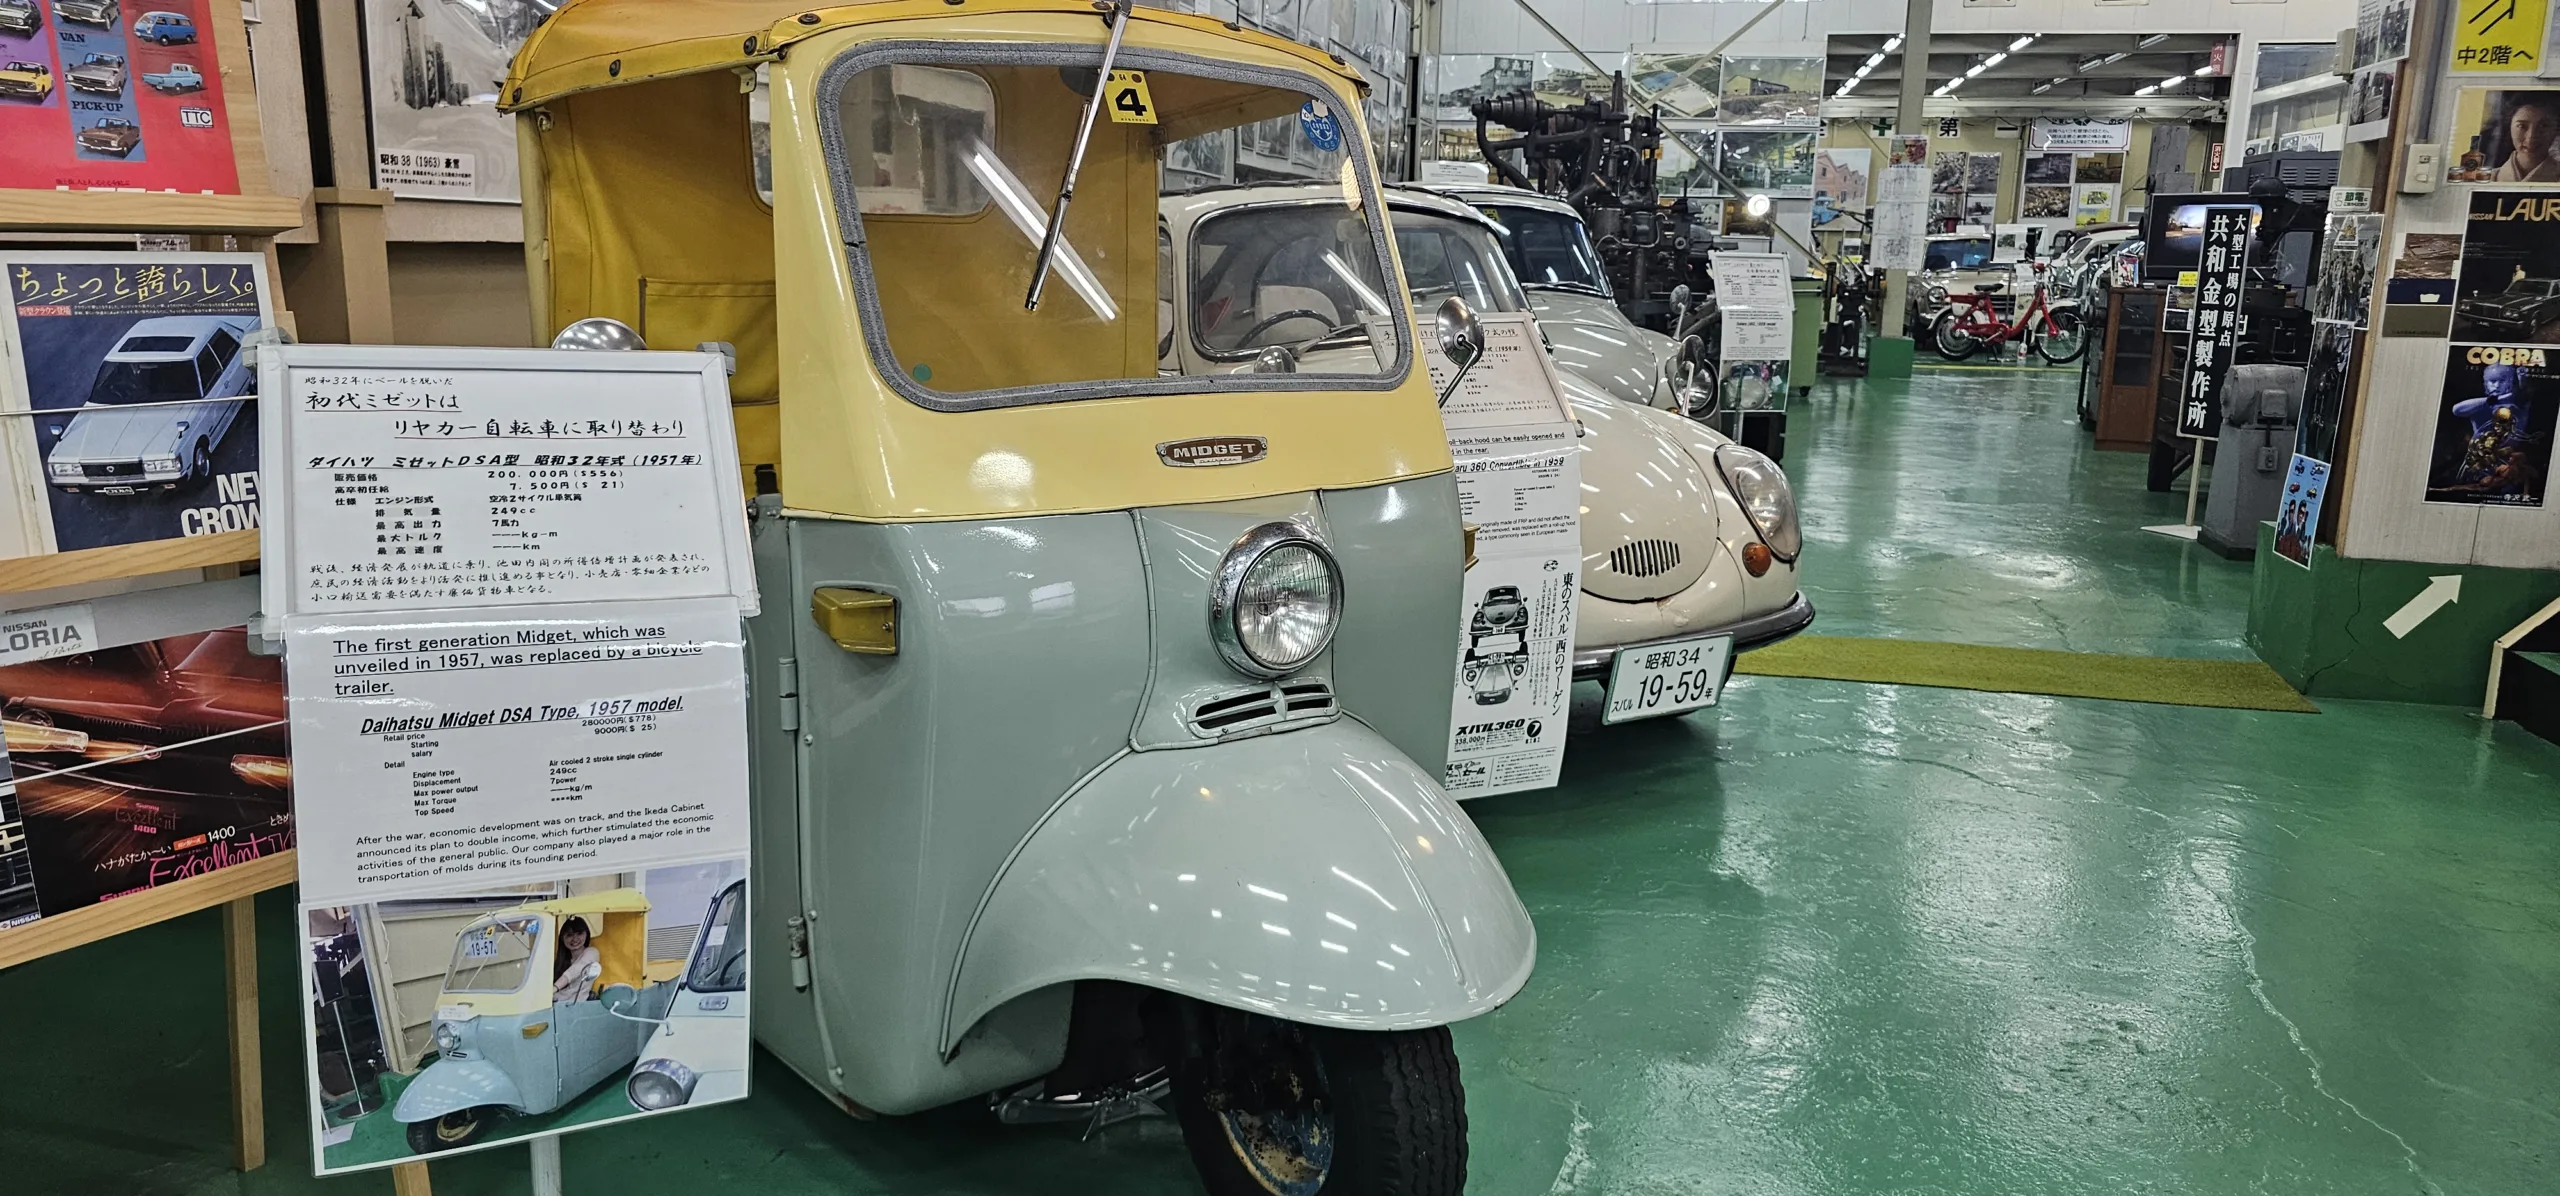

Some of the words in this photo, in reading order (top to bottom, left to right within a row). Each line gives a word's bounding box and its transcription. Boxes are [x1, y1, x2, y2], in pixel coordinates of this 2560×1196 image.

[59, 32, 85, 42] VAN
[2457, 45, 2534, 65] 中2階へ
[72, 101, 124, 112] PICK-UP
[1115, 88, 1147, 116] 4
[183, 110, 211, 124] TTC
[380, 153, 399, 166] 昭和
[401, 155, 411, 167] 38
[415, 155, 441, 168] (1963)
[16, 266, 253, 300] ちょっと誇らしく。
[2219, 214, 2246, 347] 大型工場の原点
[2186, 215, 2230, 429] 共和金型製作所
[2466, 347, 2546, 367] COBRA
[304, 376, 453, 386] 昭和32年にベールを脱いだ
[305, 391, 459, 410] 初代ミゼットは
[395, 419, 684, 438] リヤカー自転車に取り替わり
[1513, 434, 1530, 442] easily
[1531, 432, 1553, 440] opened
[1173, 443, 1256, 458] MIDGET
[1470, 462, 1486, 472] 360
[1544, 456, 1565, 467] 1959
[335, 473, 378, 482] 販売価格
[335, 486, 389, 494] 高卒初任給
[335, 498, 357, 506] 仕様
[375, 495, 434, 505] エンジン形式
[492, 519, 519, 528] 7馬力
[1557, 572, 1574, 637] 東のスバル
[3, 620, 47, 634] NISSAN
[333, 640, 368, 654] The
[375, 638, 412, 652] first
[419, 632, 510, 651] generation
[517, 629, 577, 645] Midget,
[583, 626, 629, 641] which
[635, 626, 666, 637] was
[334, 657, 409, 675] unveiled
[416, 656, 431, 670] in
[439, 653, 485, 669] 1957,
[491, 653, 523, 666] was
[530, 646, 601, 665] replaced
[607, 644, 626, 660] by
[632, 647, 641, 657] a
[647, 640, 702, 657] bicycle
[1645, 647, 1700, 670] 昭和34
[1552, 639, 1567, 716] 西のワーゲン
[335, 680, 394, 696] trailer.
[1611, 698, 1633, 713] スバル
[1638, 668, 1707, 709] 19-59
[361, 716, 434, 734] Daihatsu
[439, 709, 496, 728] Midget
[500, 707, 532, 723] DSA
[541, 705, 580, 721] Type,
[589, 699, 632, 717] 1957
[636, 696, 684, 713] model.
[1455, 718, 1526, 736] スバル360
[383, 734, 405, 742] Retail
[407, 733, 426, 741] price
[411, 741, 439, 749] Starting
[411, 750, 433, 758] salary
[561, 758, 584, 766] cooled
[593, 755, 614, 763] stroke
[616, 753, 636, 761] single
[638, 751, 664, 760] cylinder
[384, 760, 406, 769] Detail
[413, 770, 437, 779] Engine
[439, 769, 455, 778] type
[550, 767, 577, 776] 249cc
[413, 777, 461, 788] Displacement
[550, 776, 577, 785] 7power
[414, 789, 429, 797] Max
[431, 787, 453, 796] power
[456, 785, 479, 794] output
[414, 799, 429, 807] Max
[432, 797, 457, 806] Torque
[415, 809, 429, 817] Top
[431, 806, 454, 815] Speed
[356, 835, 383, 846] After
[386, 833, 402, 843] the
[405, 832, 426, 841] war,
[429, 826, 477, 838] economic
[479, 819, 540, 833] development
[543, 818, 561, 826] was
[579, 813, 605, 823] track,
[608, 810, 624, 820] and
[627, 808, 642, 817] the
[645, 806, 668, 816] Ikeda
[671, 802, 705, 813] Cabinet
[207, 825, 236, 843] 1400
[356, 845, 412, 858] announced
[415, 843, 427, 852] its
[430, 841, 451, 853] plan
[454, 840, 464, 848] to
[467, 836, 499, 847] double
[502, 832, 539, 843] income,
[542, 829, 568, 839] which
[571, 825, 603, 836] further
[606, 820, 652, 832] stimulated
[655, 818, 670, 827] the
[673, 813, 714, 825] economic
[357, 858, 403, 871] activities
[406, 857, 417, 866] of
[420, 855, 436, 864] the
[439, 851, 475, 864] general
[478, 847, 509, 859] public.
[511, 845, 529, 854] Our
[533, 841, 574, 853] company
[577, 838, 596, 847] also
[599, 834, 628, 846] played
[639, 830, 663, 841] major
[666, 828, 683, 837] role
[686, 826, 694, 835] in
[697, 825, 711, 834] the
[358, 869, 429, 884] transportation
[433, 867, 444, 876] of
[445, 863, 474, 874] molds
[477, 861, 507, 870] during
[509, 858, 522, 867] its
[524, 853, 564, 865] founding
[567, 850, 598, 861] period.
[11, 914, 42, 928] NISSAN
